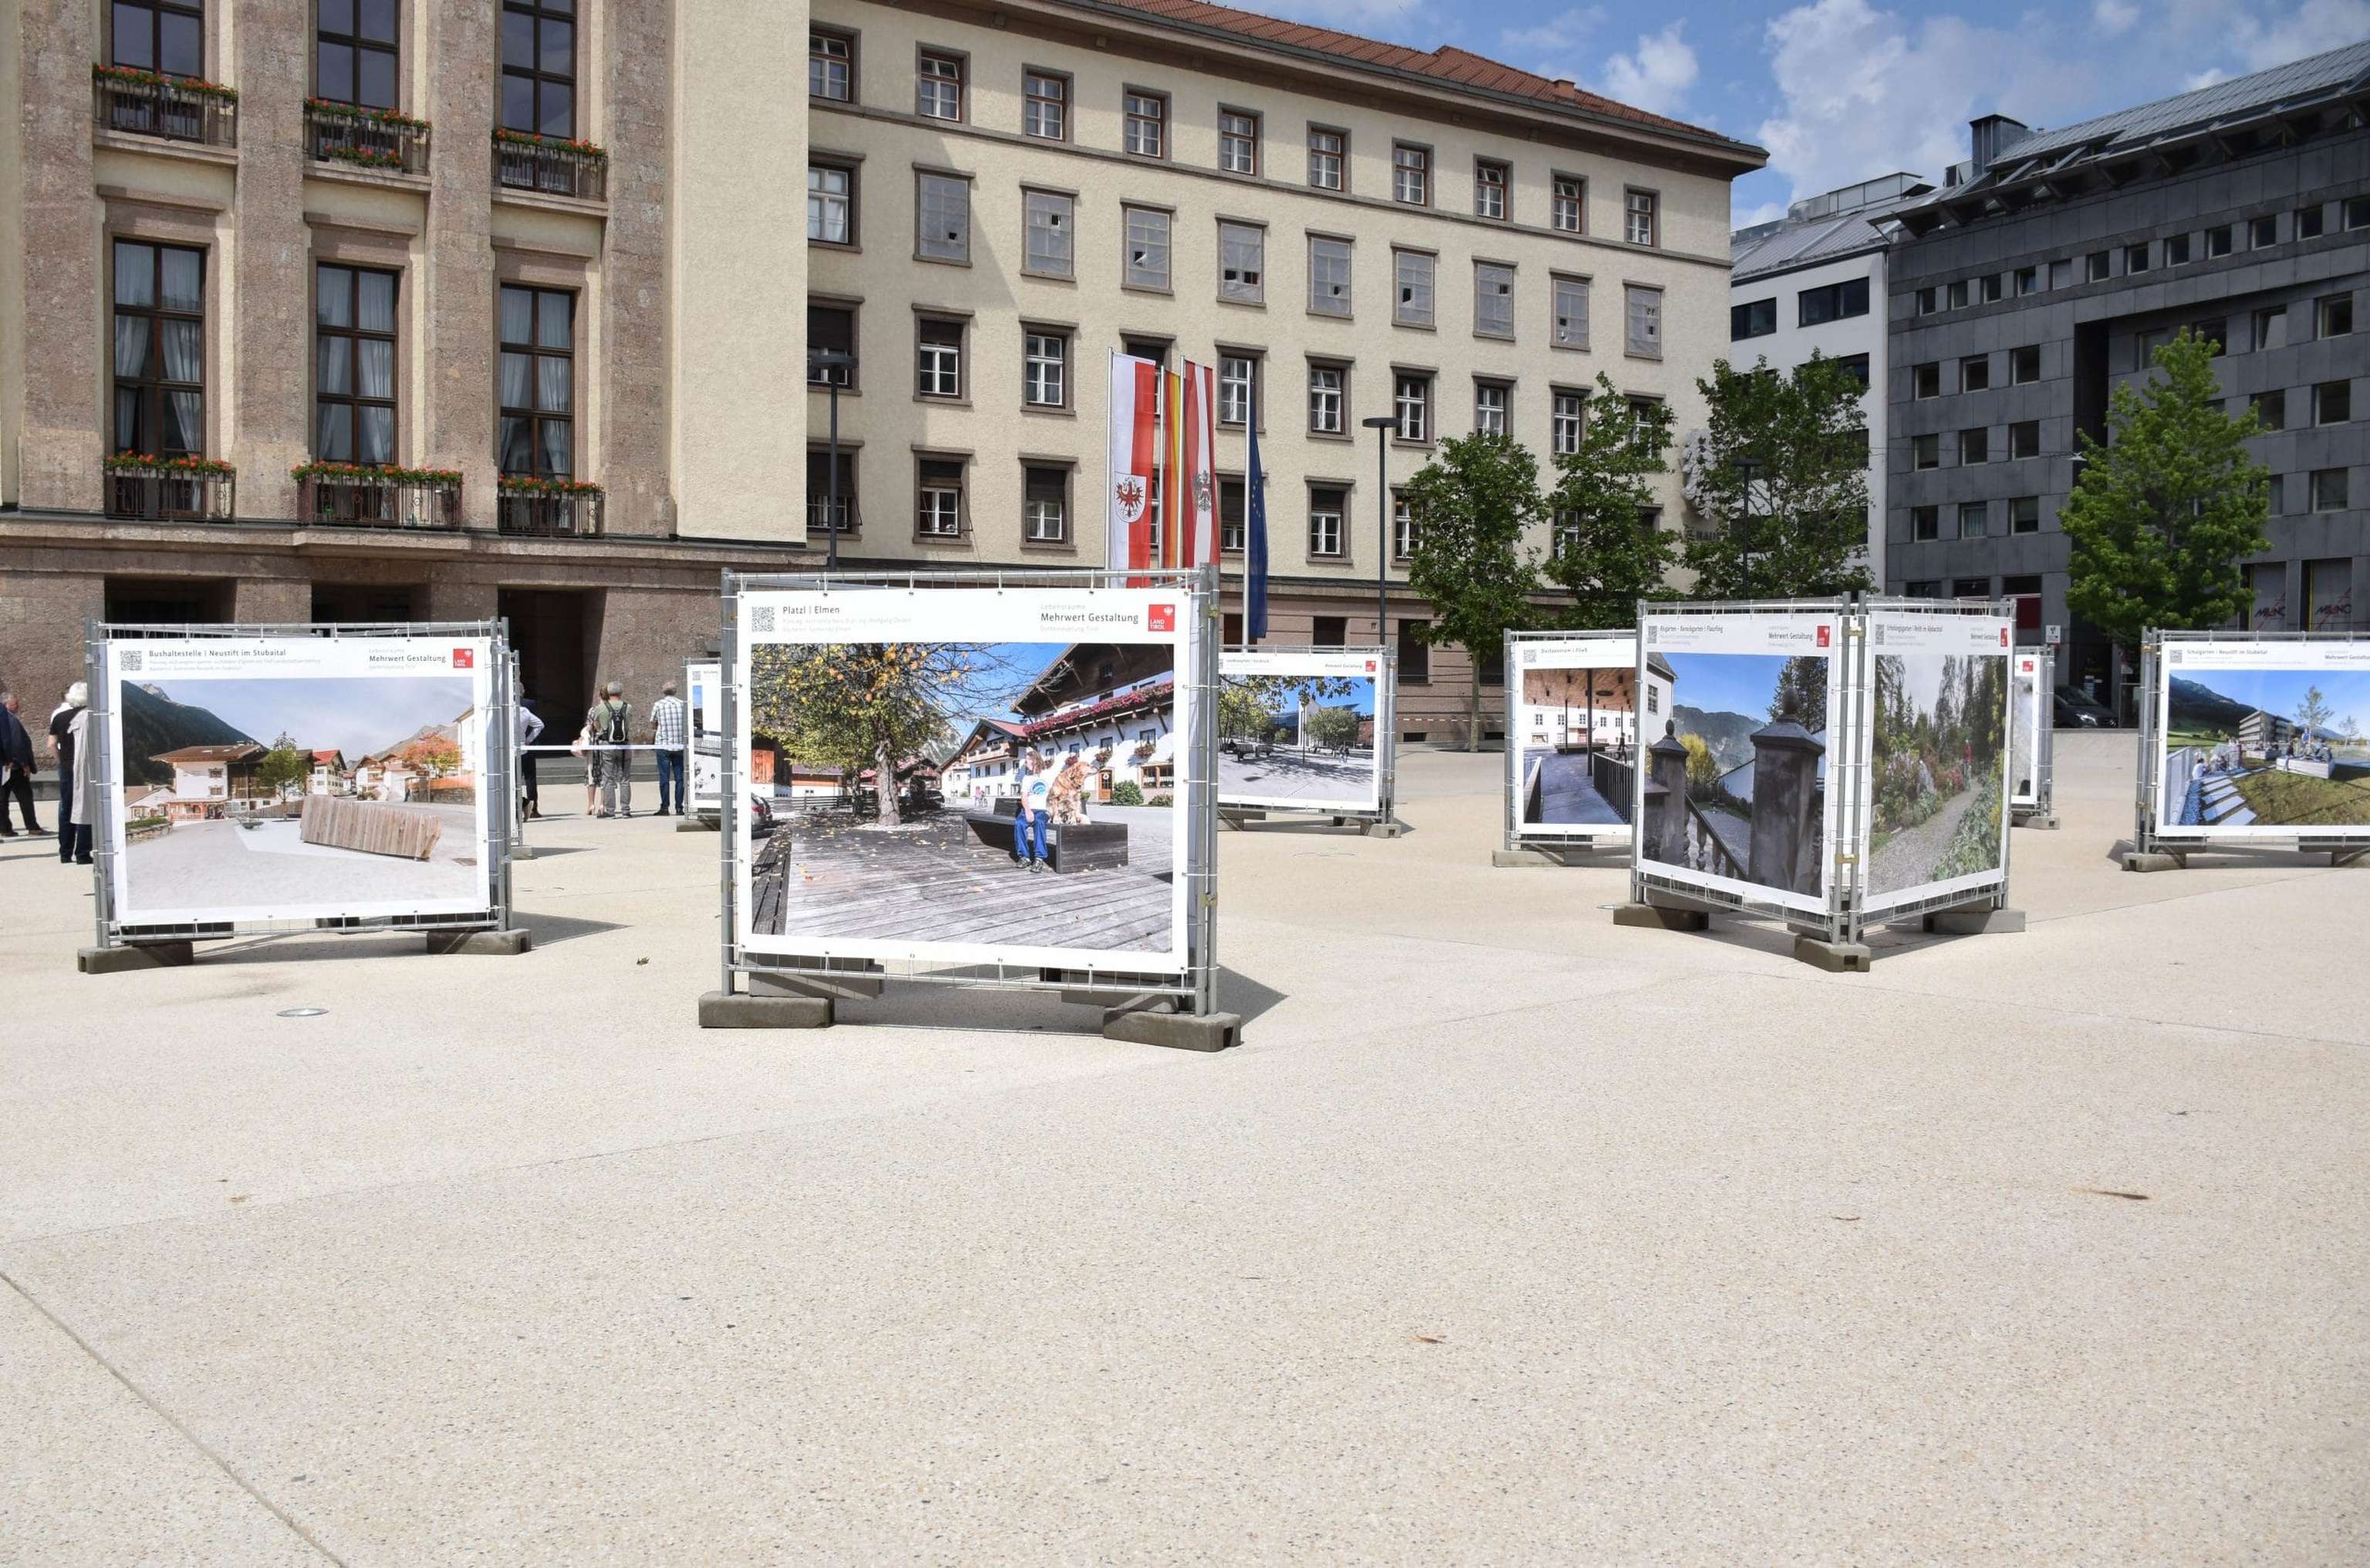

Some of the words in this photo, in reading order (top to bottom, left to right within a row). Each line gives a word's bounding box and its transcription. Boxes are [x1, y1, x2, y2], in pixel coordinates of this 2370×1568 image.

[782, 605, 805, 615] Platzl
[814, 605, 839, 615] Elmen
[1041, 612, 1085, 622] Mehrwert
[1088, 612, 1139, 625] Gestaltung
[1790, 632, 1813, 642] Gestaltung
[209, 649, 238, 657] Neustift
[253, 648, 286, 656] Stubaital
[370, 654, 404, 663] Mehrwert
[406, 654, 446, 664] Gestaltung
